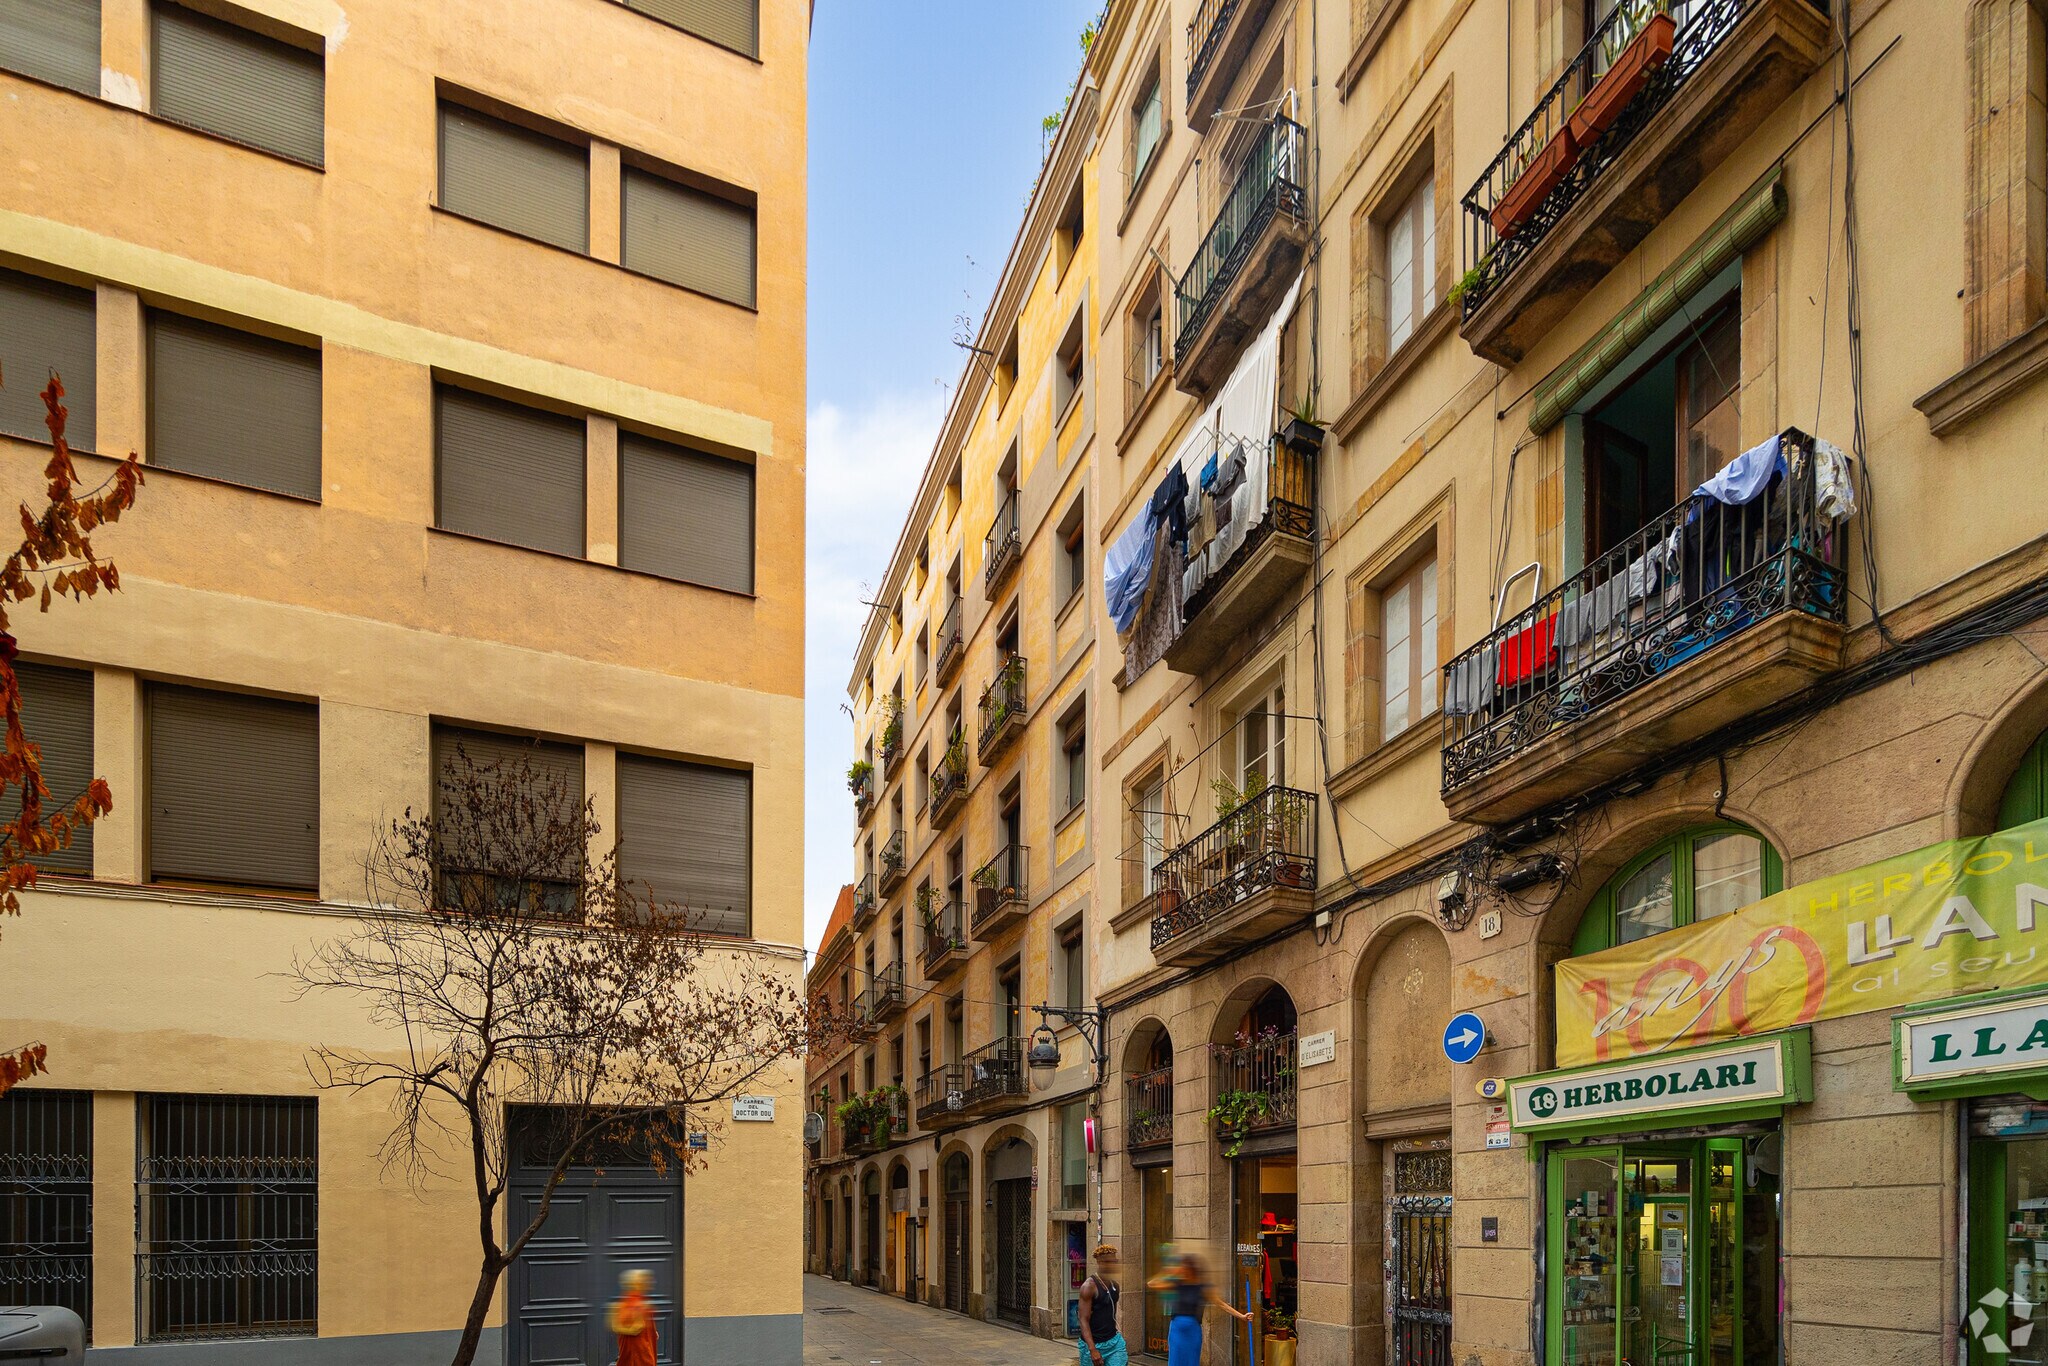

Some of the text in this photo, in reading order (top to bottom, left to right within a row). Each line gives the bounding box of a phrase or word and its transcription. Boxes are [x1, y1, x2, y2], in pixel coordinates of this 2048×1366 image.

[1484, 916, 1495, 933] 18
[1852, 946, 2036, 993] al seu
[1578, 925, 1827, 1063] 100 anys
[1307, 1037, 1326, 1047] CARRER
[1532, 1061, 1757, 1111] 18 HERBOLARI
